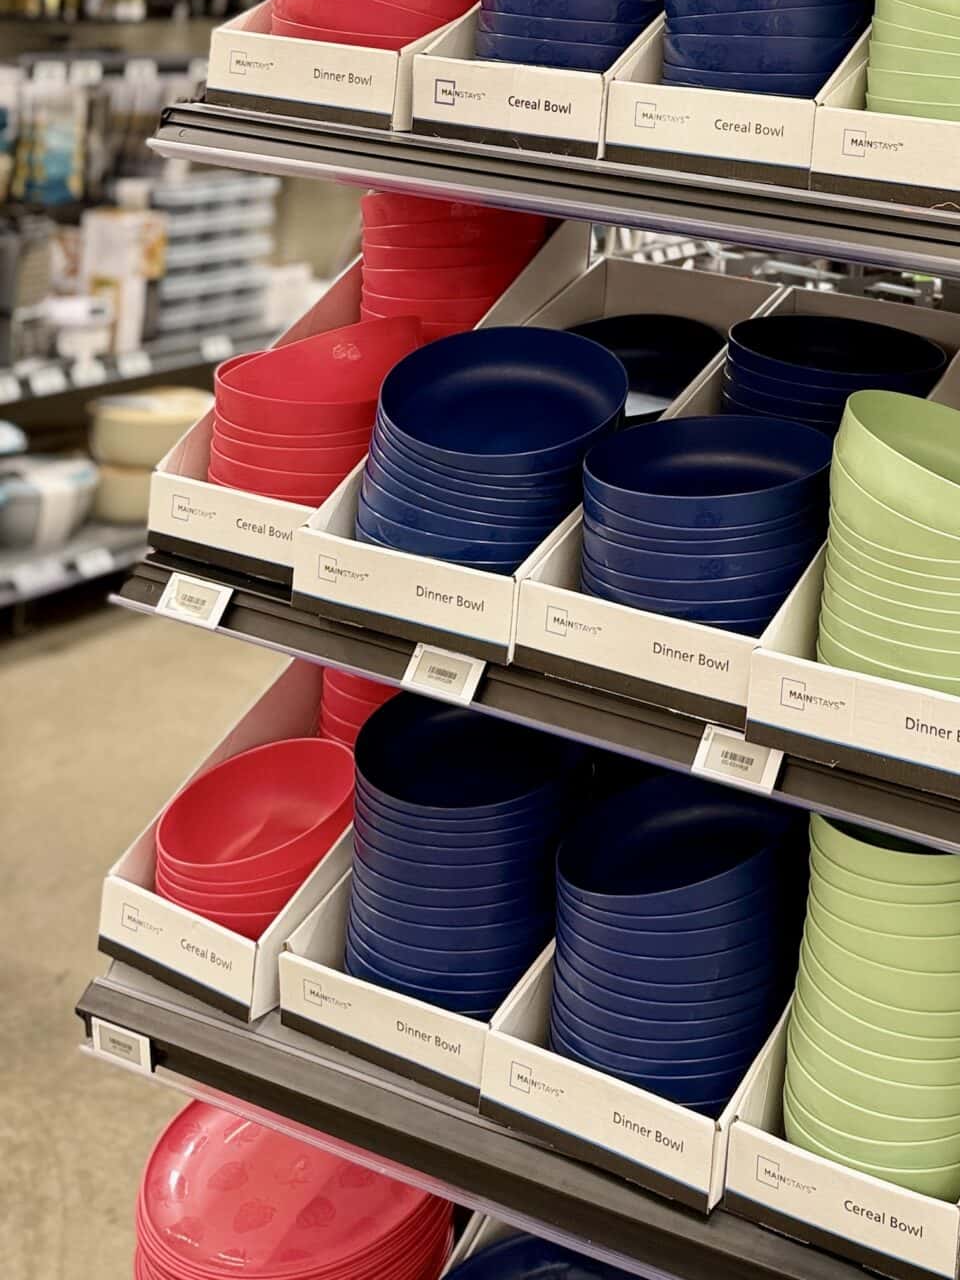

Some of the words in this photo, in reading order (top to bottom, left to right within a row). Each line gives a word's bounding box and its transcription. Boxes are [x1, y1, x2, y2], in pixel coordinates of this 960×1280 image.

[313, 68, 345, 83] Dinner
[348, 72, 371, 87] Bowl
[508, 95, 540, 111] Cereal
[544, 101, 571, 114] Bowl
[714, 119, 751, 135] Cereal
[755, 123, 784, 137] Bowl
[236, 518, 266, 534] Cereal
[269, 525, 293, 541] Bowl
[416, 584, 453, 604] Dinner
[457, 595, 484, 612] Bowl
[653, 642, 694, 664] Dinner
[698, 653, 729, 672] Bowl
[905, 716, 953, 742] Dinner
[180, 938, 208, 961] Cereal
[210, 952, 233, 971] Bowl
[396, 1021, 431, 1044] Dinner
[435, 1035, 461, 1056] Bowl
[613, 1112, 651, 1138] Dinner
[655, 1128, 684, 1153] Bowl
[844, 1199, 886, 1225] Cereal
[890, 1214, 923, 1239] Bowl
